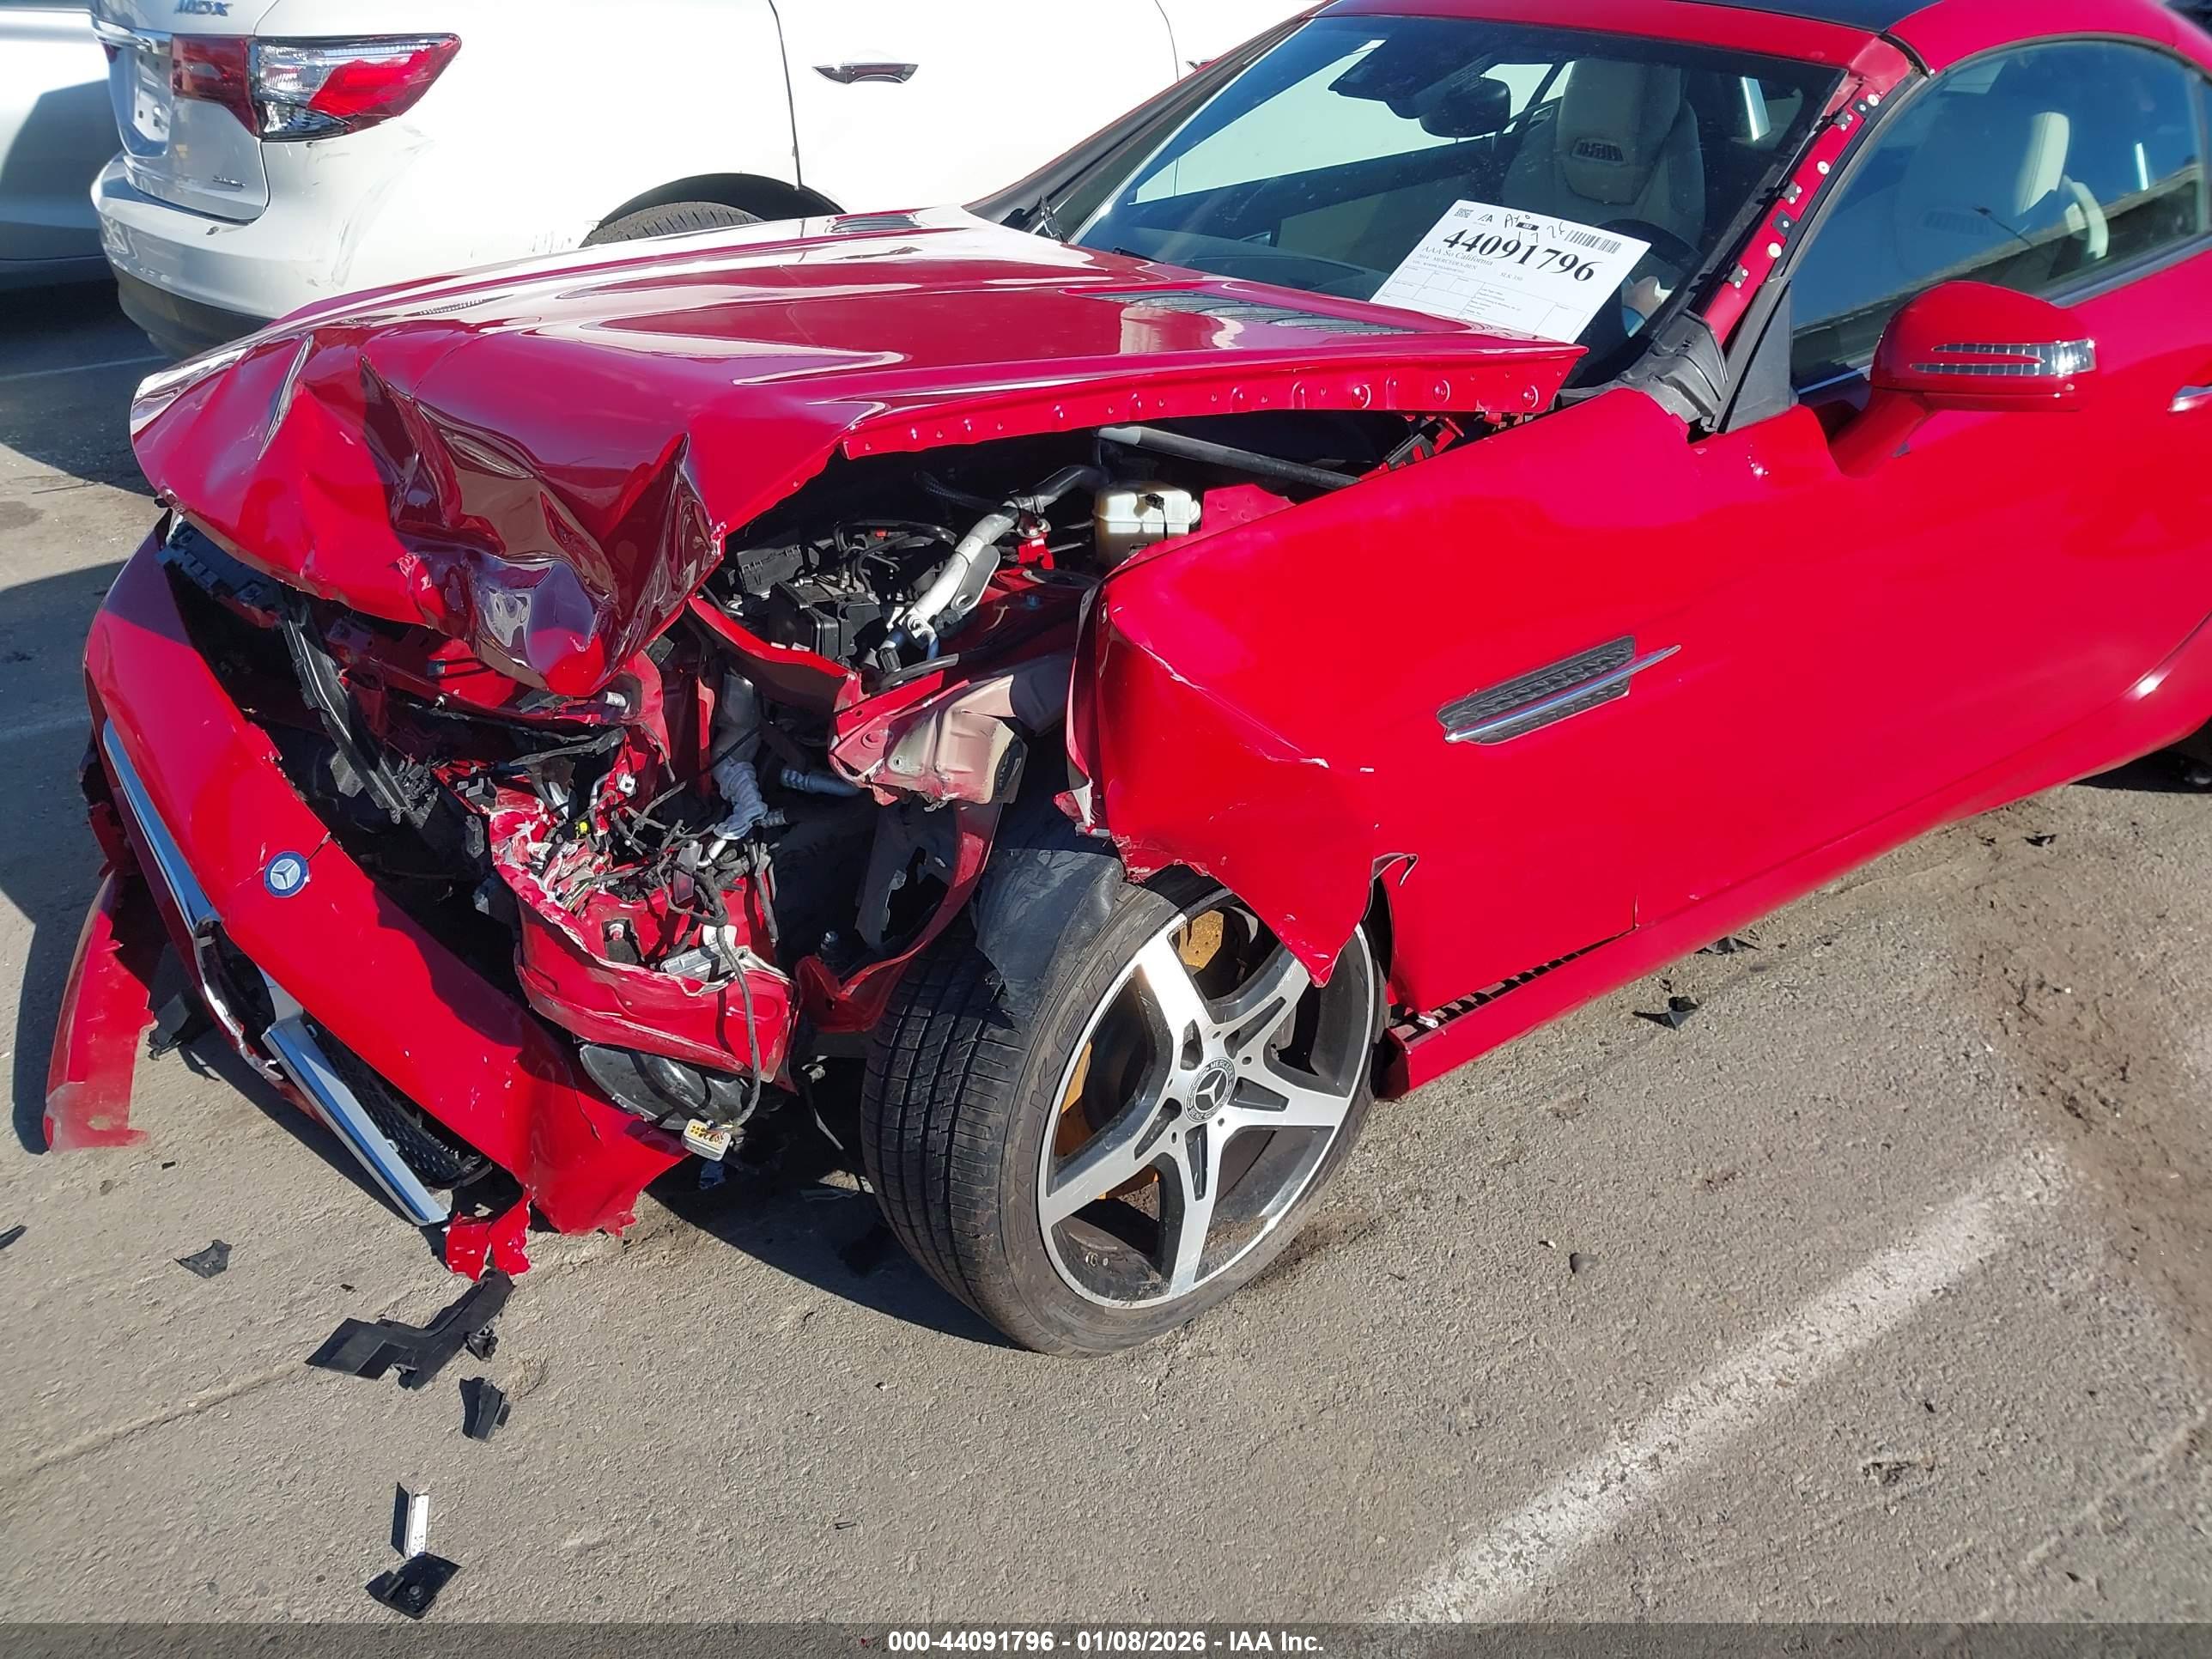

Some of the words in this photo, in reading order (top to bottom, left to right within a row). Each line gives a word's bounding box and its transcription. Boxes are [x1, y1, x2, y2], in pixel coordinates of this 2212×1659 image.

[1443, 228, 1602, 282] 44091796
[1455, 252, 1494, 266] California
[1188, 1107, 1205, 1120] BENZ
